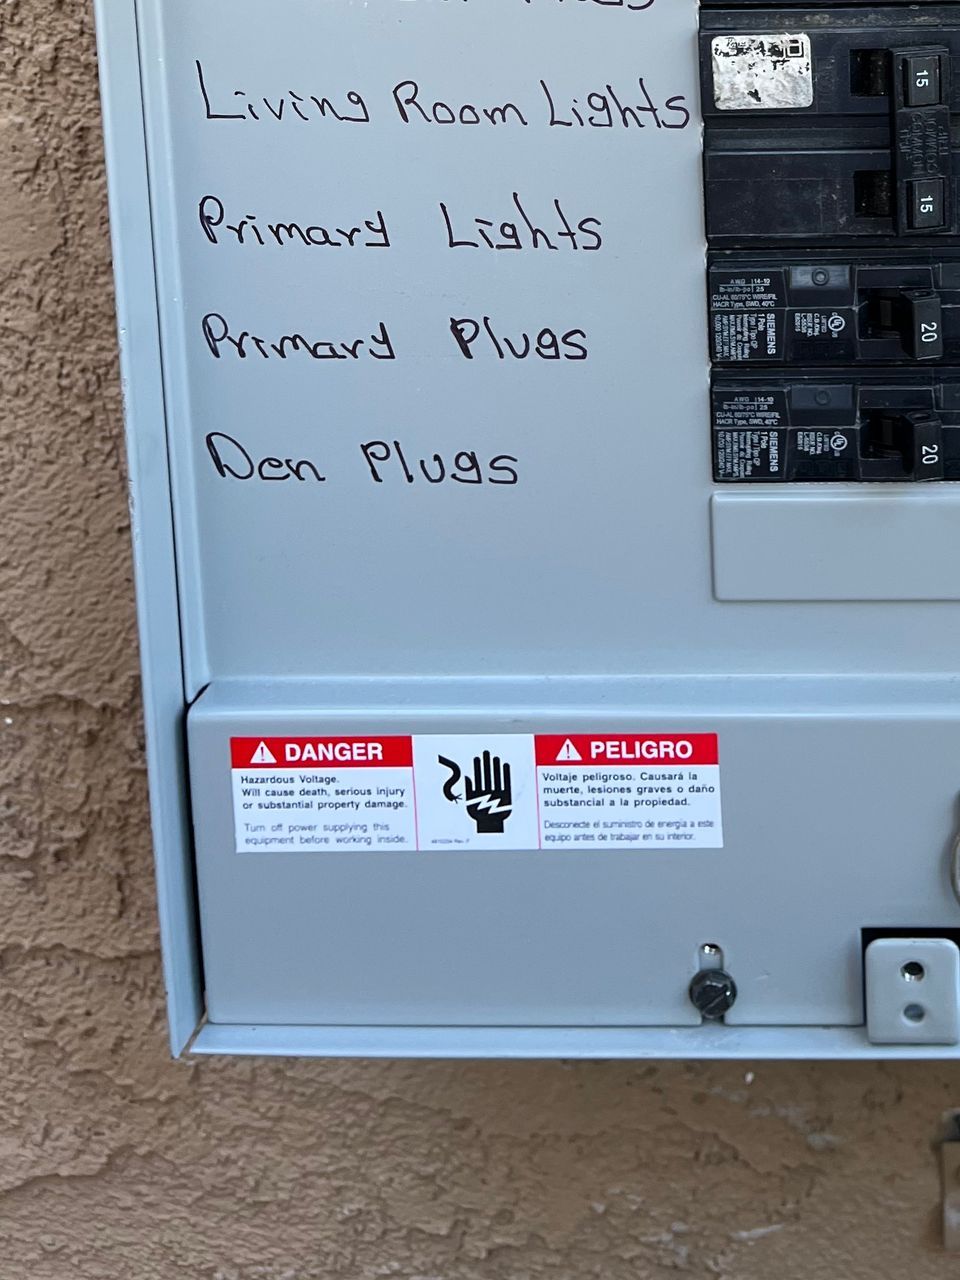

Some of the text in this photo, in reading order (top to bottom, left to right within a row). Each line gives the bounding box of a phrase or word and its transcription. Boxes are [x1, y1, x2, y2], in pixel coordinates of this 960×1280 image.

[916, 70, 928, 88] 15
[196, 59, 690, 129] Living Room Lights
[921, 196, 933, 213] 15
[198, 191, 603, 251] Primary Lights
[202, 312, 588, 361] Primary Plugs
[767, 314, 776, 355] SIEMENS
[921, 322, 937, 342] 20
[206, 431, 519, 485] Den Plugs
[770, 431, 778, 472] SIEMENS
[922, 445, 938, 464] 20
[285, 743, 383, 761] DANGER
[591, 741, 693, 759] PELIGRO
[241, 776, 340, 785] Hazardous Voltage.
[543, 772, 698, 783] Voltaje peligroso. Causará la
[299, 789, 330, 797] death,
[376, 788, 405, 797] injury
[543, 786, 583, 794] muerte,
[588, 785, 632, 793] lesiones
[637, 786, 672, 795] graves
[689, 785, 715, 793] daño
[258, 801, 313, 809] substantial
[318, 801, 359, 810] property
[365, 800, 407, 809] damage.
[544, 798, 604, 807] substancial
[620, 798, 629, 806] la
[634, 798, 691, 807] propiedad.
